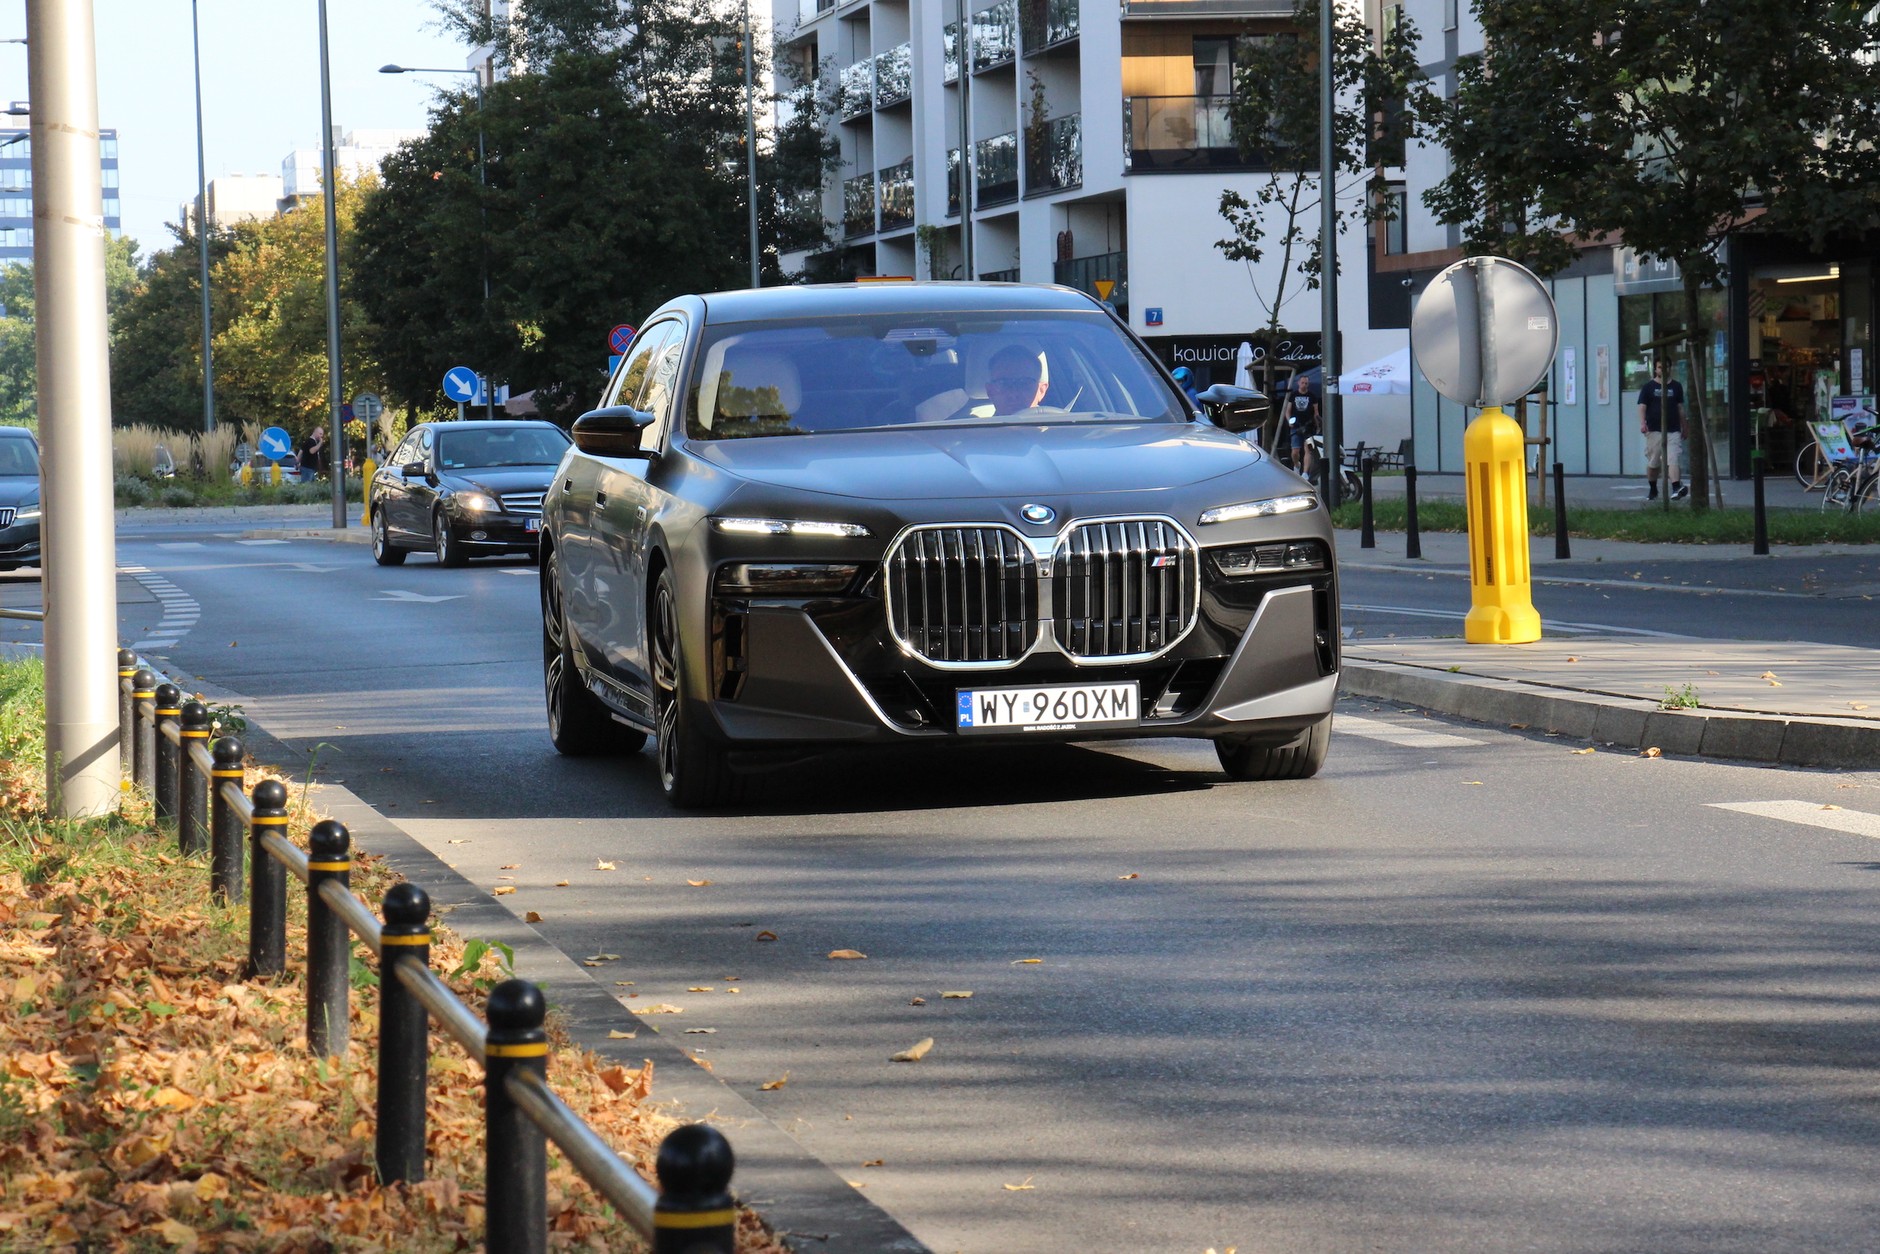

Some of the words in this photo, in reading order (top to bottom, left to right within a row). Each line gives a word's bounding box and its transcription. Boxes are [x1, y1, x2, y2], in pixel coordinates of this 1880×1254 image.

[1151, 311, 1158, 321] 7
[1173, 344, 1266, 361] kawiara
[980, 693, 1018, 724] WY
[1033, 688, 1130, 721] 960XM
[960, 713, 972, 722] PL
